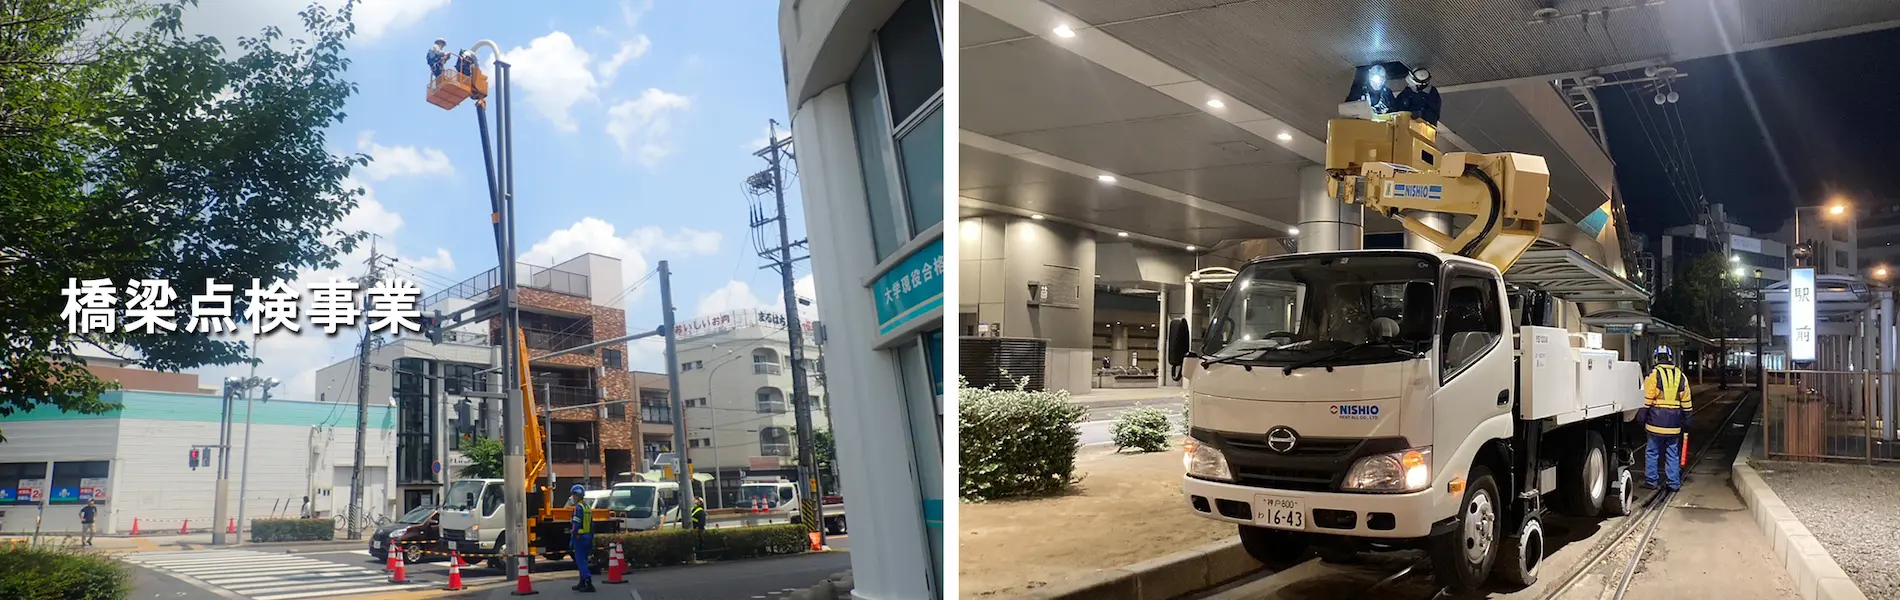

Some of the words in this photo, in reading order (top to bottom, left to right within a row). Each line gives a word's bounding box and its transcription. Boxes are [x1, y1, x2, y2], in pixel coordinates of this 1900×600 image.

[1405, 184, 1428, 198] NISHIO
[884, 255, 944, 305] 大学現役合格
[675, 314, 730, 334] おいしいお肉
[1794, 287, 1811, 342] 駅前
[1340, 405, 1379, 415] NISHIO
[1268, 508, 1302, 527] 16-43
